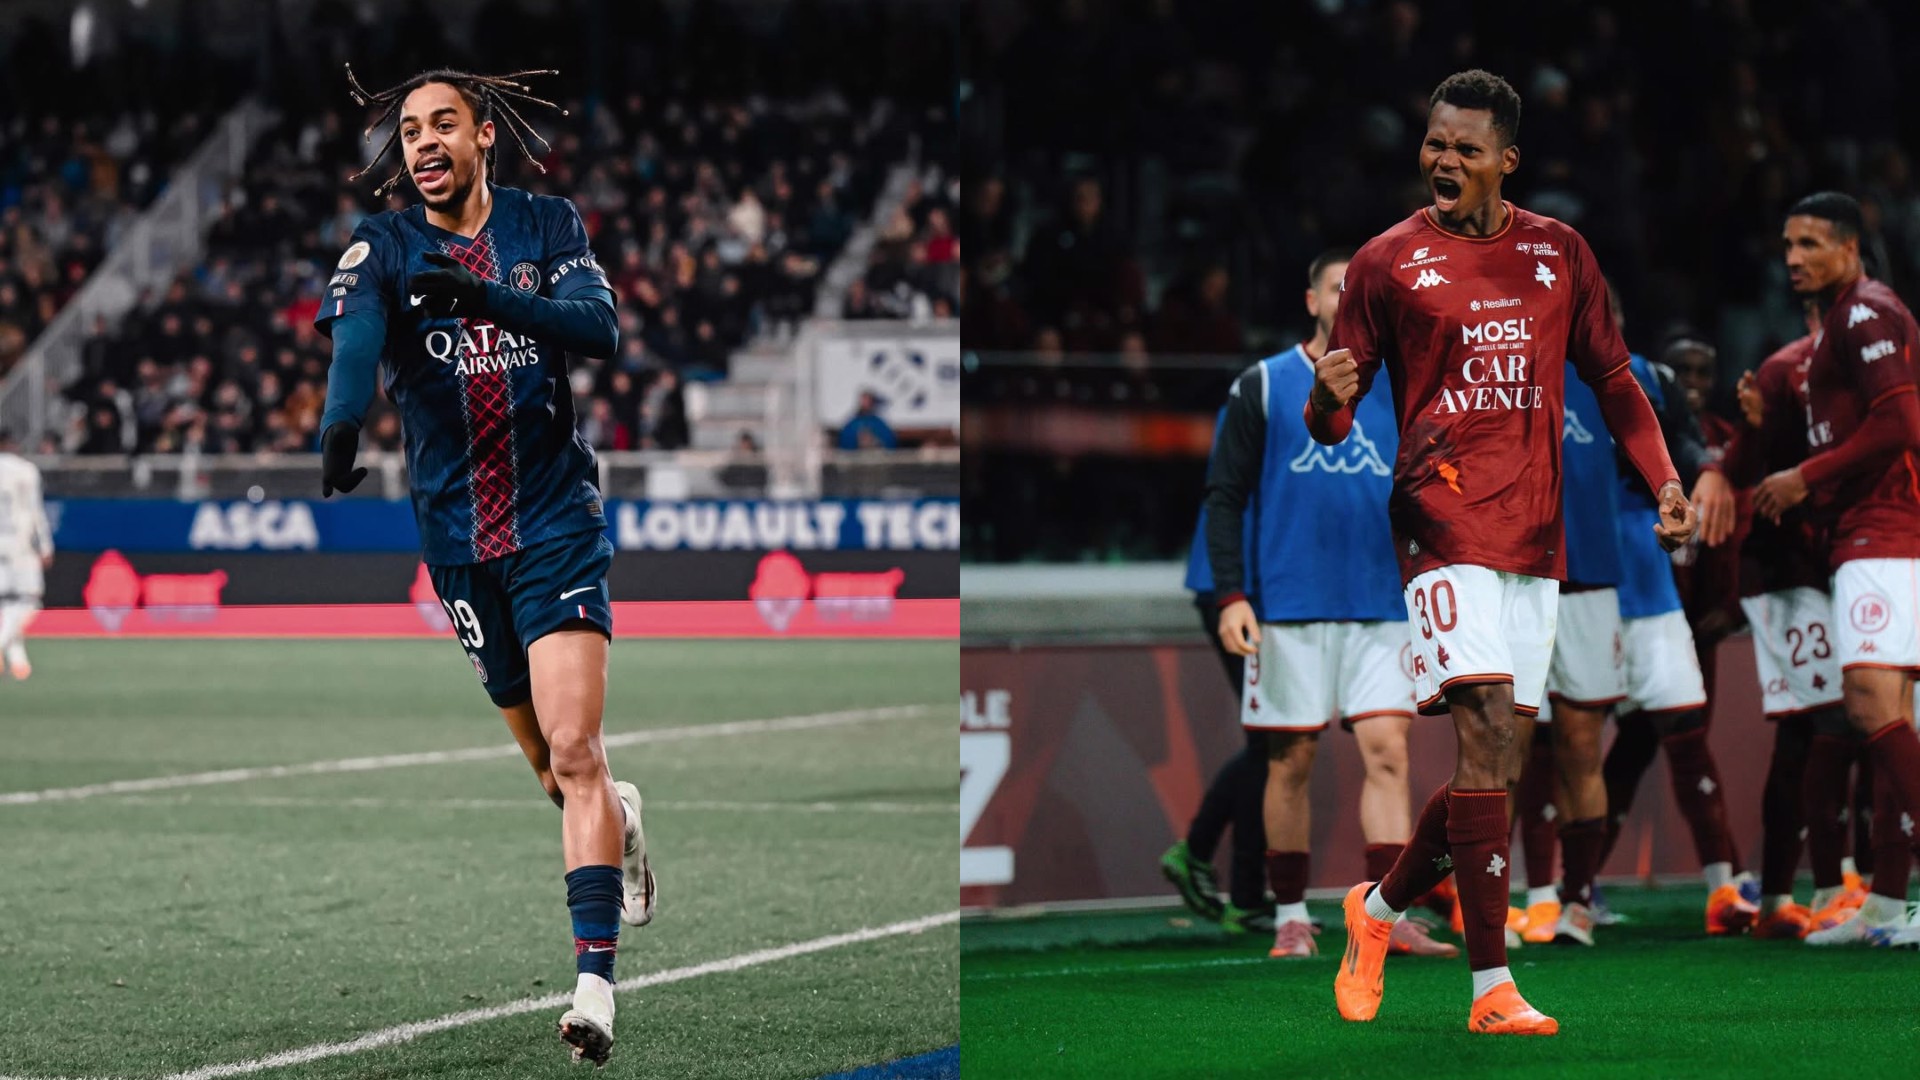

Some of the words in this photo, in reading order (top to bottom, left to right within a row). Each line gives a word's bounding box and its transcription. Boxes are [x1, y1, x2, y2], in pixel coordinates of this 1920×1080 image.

[513, 264, 534, 274] PARIS
[1483, 298, 1522, 309] Resilium
[1462, 317, 1533, 345] MOSL
[455, 347, 539, 376] AIRWAYS
[1462, 355, 1527, 383] CAR
[1434, 386, 1543, 414] AVENUE
[188, 502, 319, 549] ASCA
[616, 503, 845, 549] LOUAULT
[1414, 579, 1458, 640] 30
[1785, 622, 1832, 667] 23
